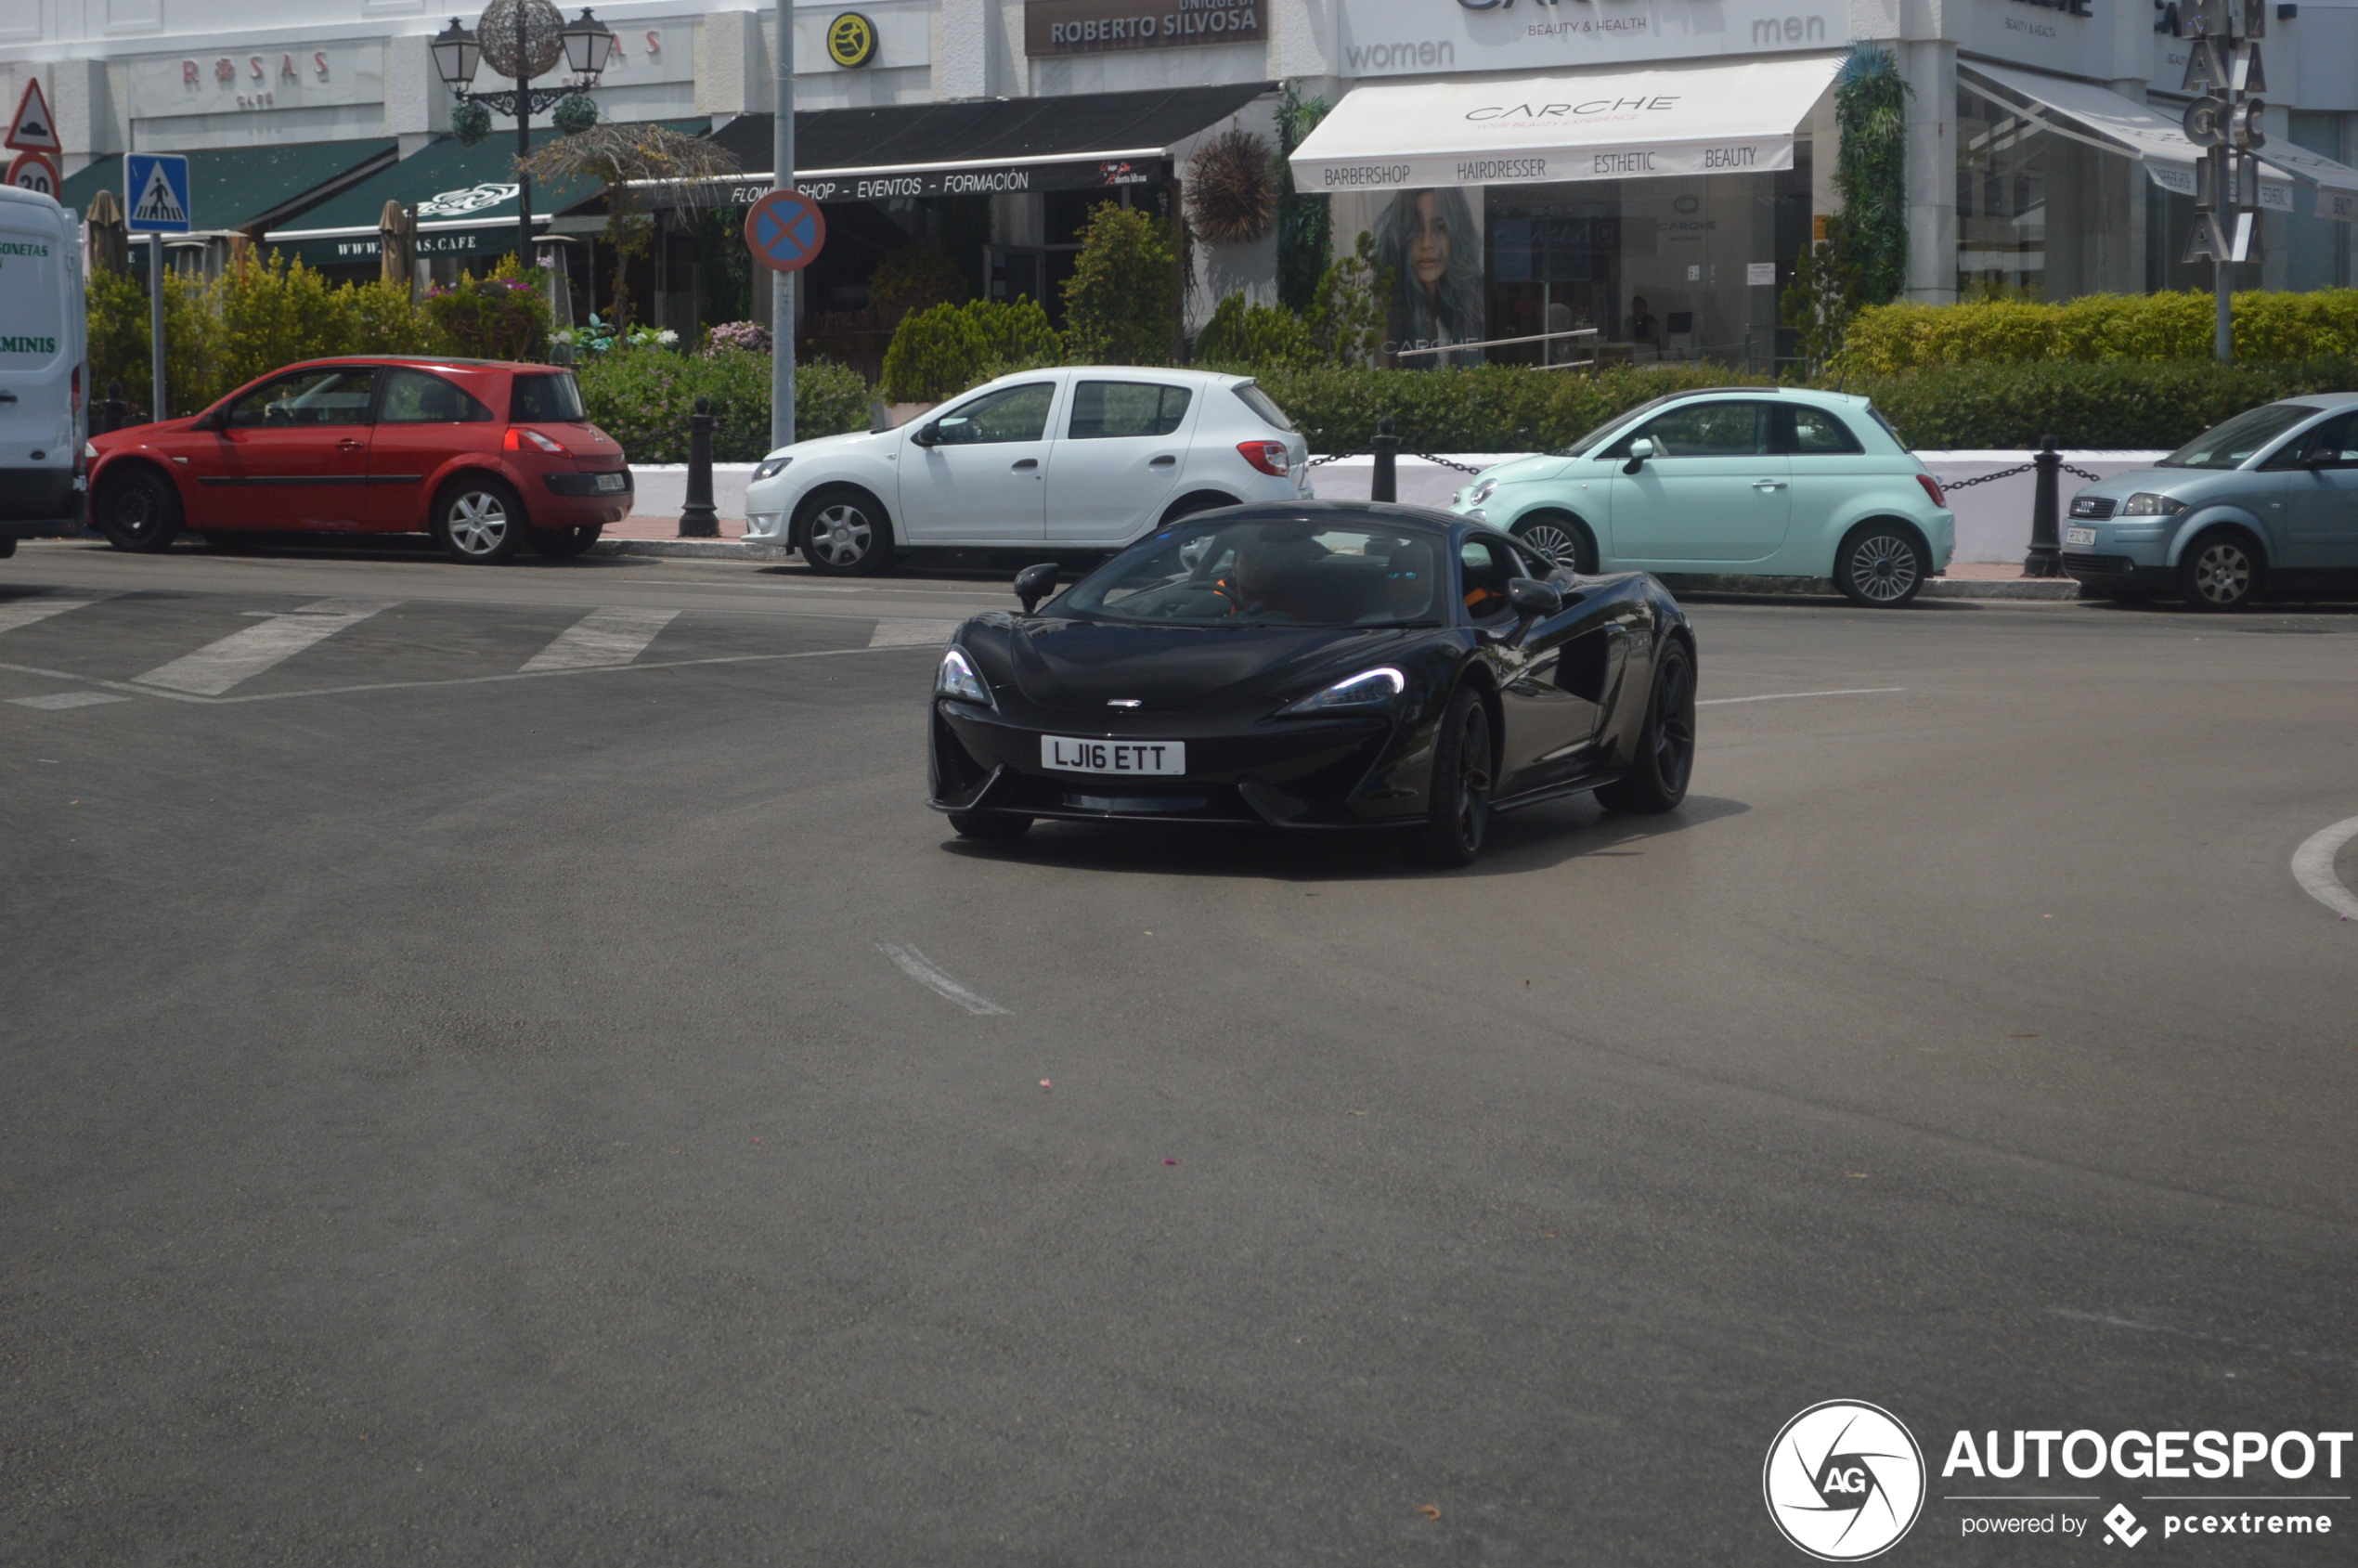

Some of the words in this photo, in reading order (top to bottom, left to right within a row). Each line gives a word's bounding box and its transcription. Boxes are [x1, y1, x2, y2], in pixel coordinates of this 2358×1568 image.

[1052, 16, 1157, 43] ROBERTO
[1163, 9, 1257, 36] SILVOSA
[1528, 22, 1578, 36] BEAUTY
[1583, 21, 1593, 33] &
[1596, 18, 1647, 32] HEALTH
[1752, 15, 1825, 45] men
[1346, 39, 1455, 69] women
[1476, 121, 1510, 130] YOUR
[1511, 120, 1559, 128] BEAUTY
[1562, 113, 1640, 126] EXPERIENCE
[1325, 164, 1410, 186] BARBERSHOP
[1458, 159, 1546, 180] HAIRDRESSER
[1594, 151, 1655, 173] ESTHETIC
[1705, 147, 1756, 168] BEAUTY
[732, 186, 776, 202] FLOW
[797, 183, 836, 201] SHOP
[858, 177, 922, 198] EVENTOS
[944, 168, 1029, 192] FORMACIÓN
[1055, 741, 1107, 769] LJ16
[1115, 745, 1166, 771] ETT
